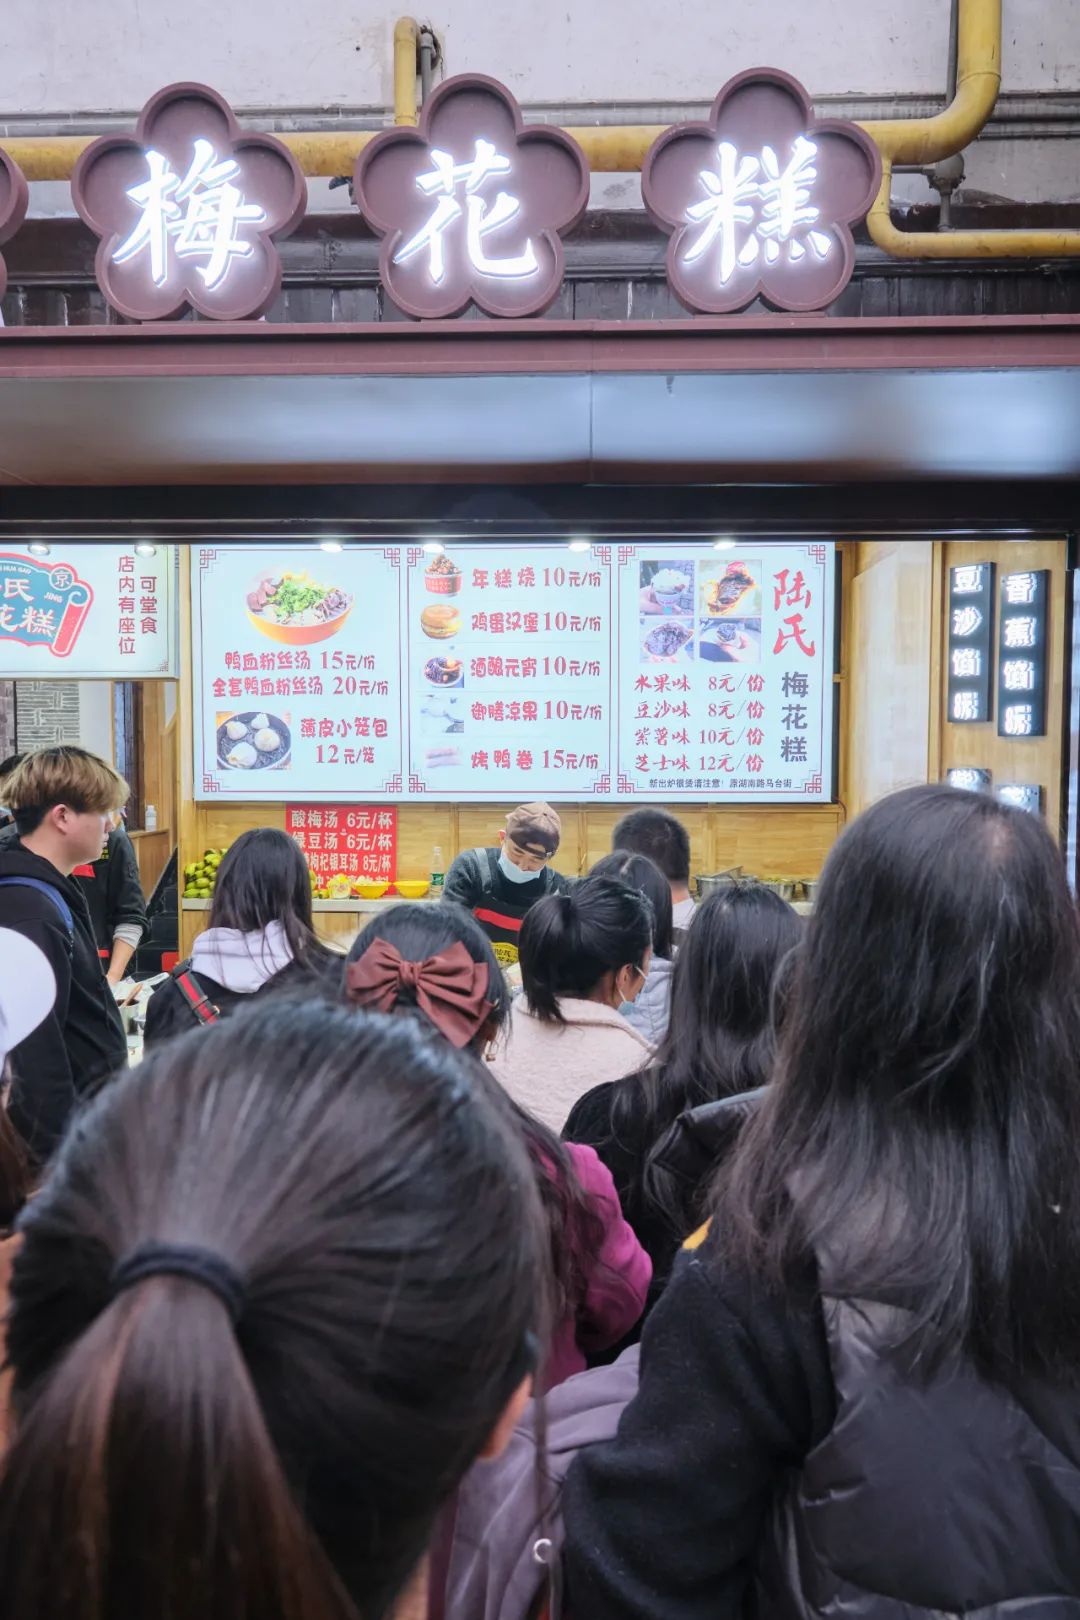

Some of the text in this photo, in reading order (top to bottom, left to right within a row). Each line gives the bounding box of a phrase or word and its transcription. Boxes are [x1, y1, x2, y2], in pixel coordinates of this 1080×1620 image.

[112, 136, 832, 291] 梅花糕
[54, 570, 71, 588] 京
[471, 567, 535, 589] 年糕烧
[543, 567, 601, 588] 10元/份
[0, 578, 35, 603] 氏
[118, 555, 136, 655] 店内有座位
[140, 576, 158, 635] 可堂食
[471, 611, 602, 633] 鸡蛋汉堡 10元/份
[225, 651, 375, 671] 鸭血粉丝汤 15元/份
[471, 656, 600, 678] 酒酿元宵 10元/份
[773, 568, 815, 762] 陆氏 梅花糕
[212, 676, 389, 697] 全套鸭血粉丝汤 20元/份
[634, 673, 766, 693] 水果味 8元/份
[543, 700, 602, 721] 10元/份
[634, 699, 765, 719] 豆沙味 8元/份
[300, 716, 388, 738] 薄皮小笼包
[634, 727, 765, 746] 紫薯味 10元/份
[471, 749, 599, 770] 烤鸭卷 15元/份
[634, 753, 764, 773] 芝士味 12元/份
[291, 810, 393, 830] 酸梅汤 6元/杯
[346, 833, 392, 851] 6元/杯
[362, 854, 391, 873] 8元/杯
